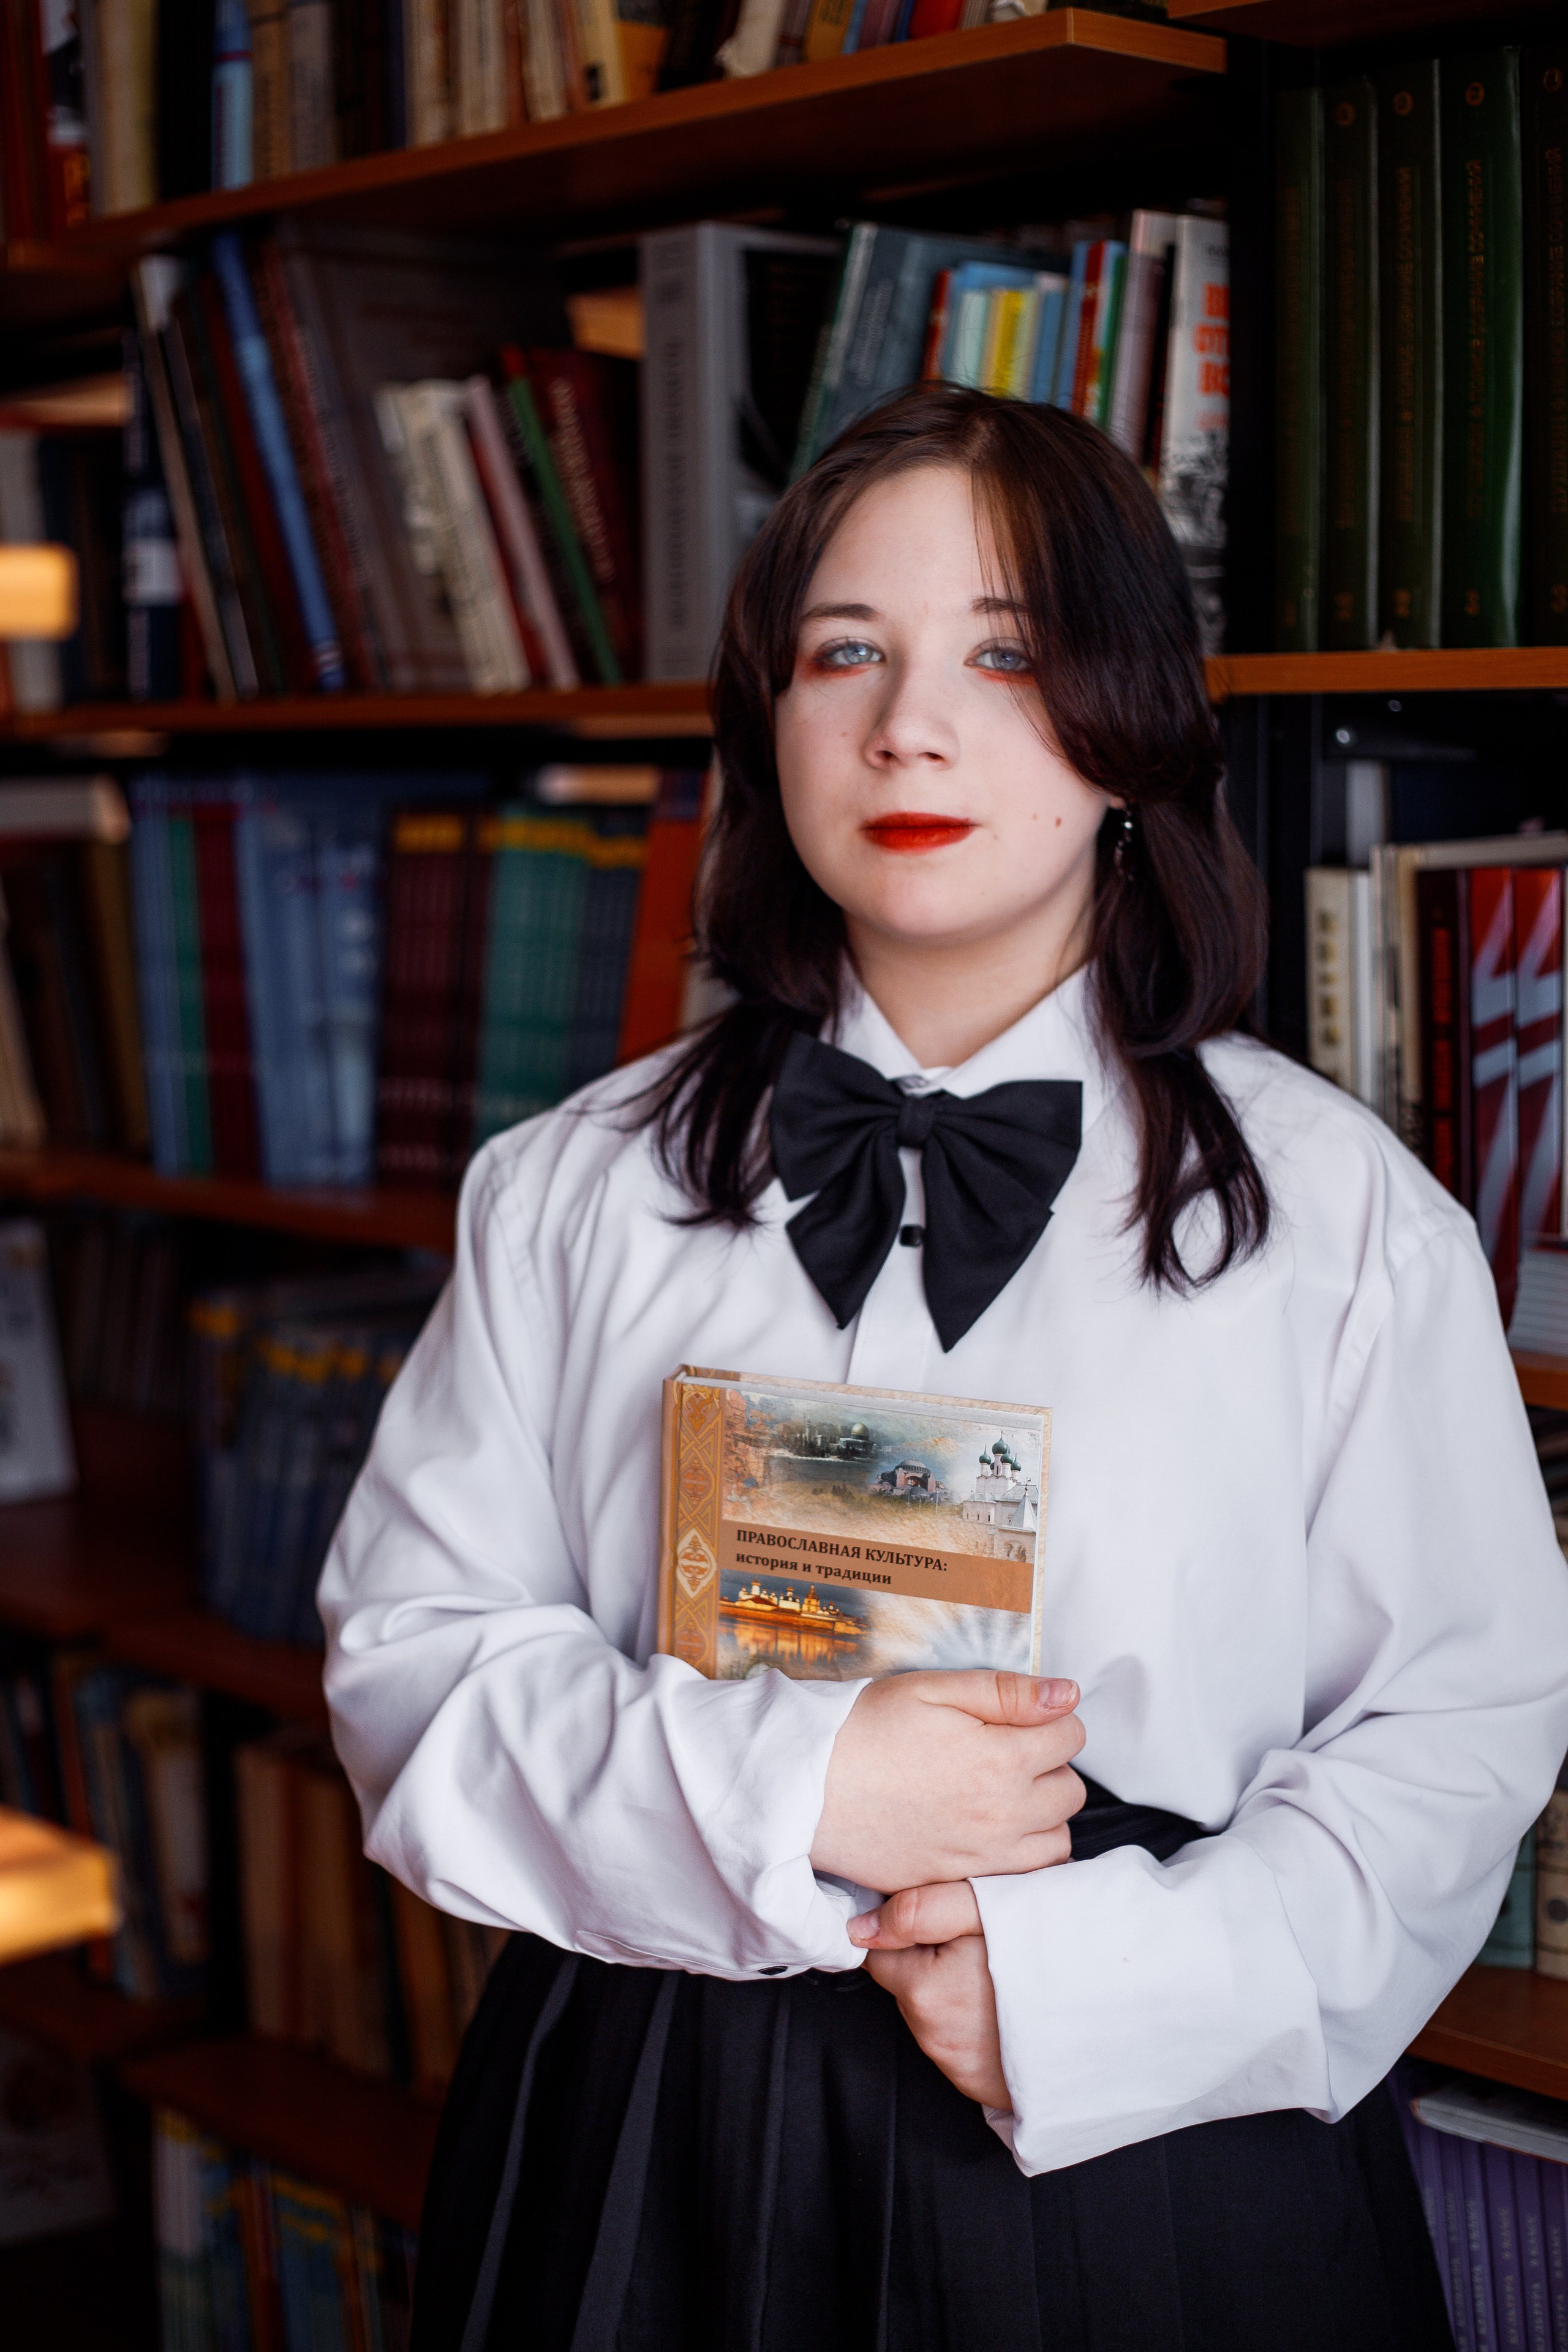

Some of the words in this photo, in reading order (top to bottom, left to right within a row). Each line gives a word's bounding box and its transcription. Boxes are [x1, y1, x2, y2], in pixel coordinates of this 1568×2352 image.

[736, 1529, 861, 1559] ПРАВОСЛАВНАЯ
[865, 1548, 948, 1571] КУЛЬТУРА:
[736, 1553, 797, 1571] история
[802, 1563, 812, 1572] и
[816, 1564, 892, 1585] традиции
